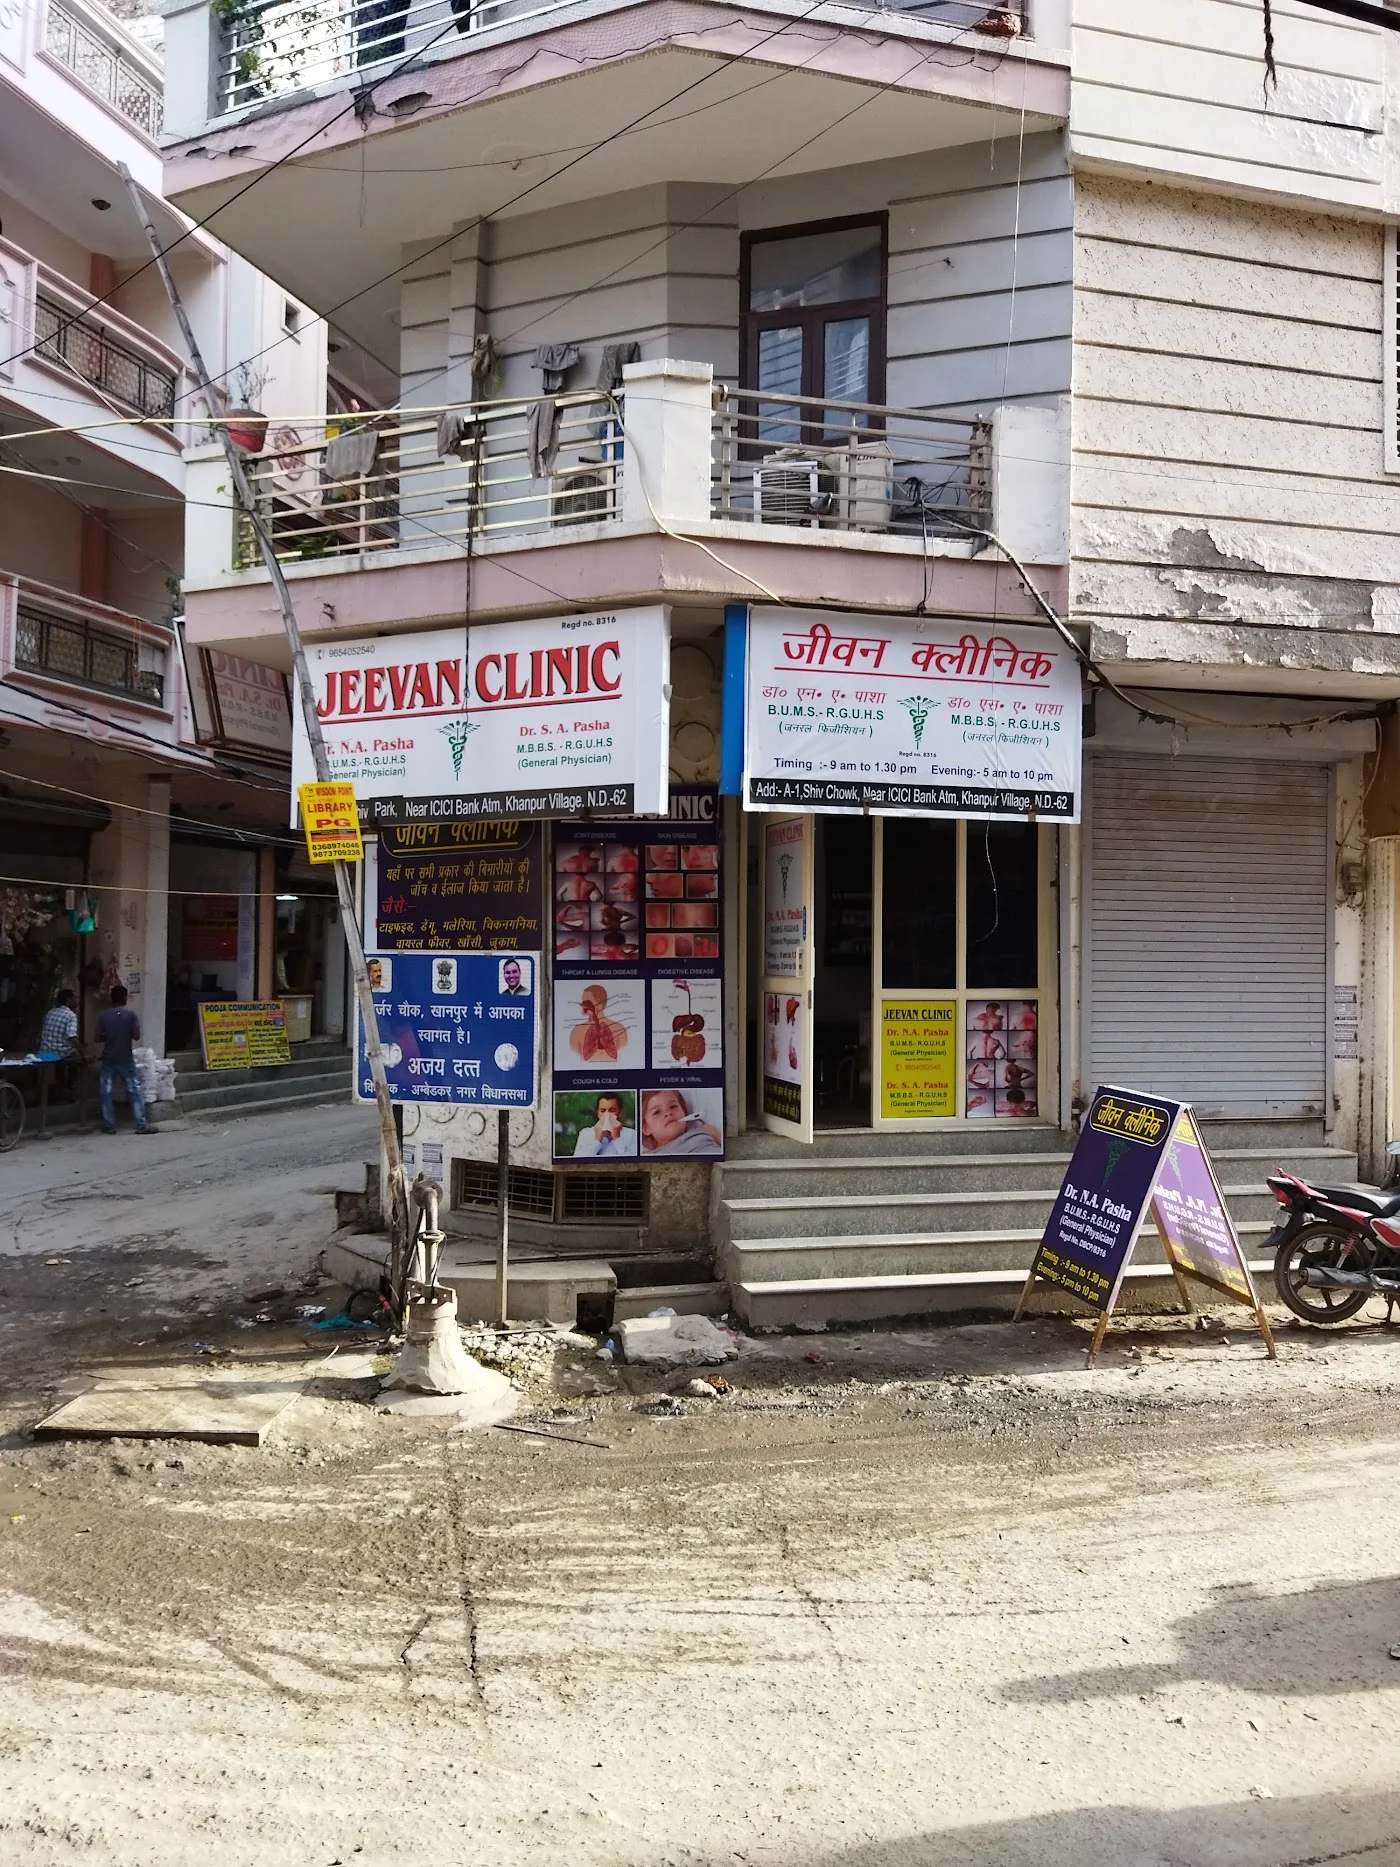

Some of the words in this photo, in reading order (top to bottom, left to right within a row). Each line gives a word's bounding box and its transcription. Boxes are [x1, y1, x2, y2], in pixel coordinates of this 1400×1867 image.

[561, 620, 581, 630] Regd
[596, 616, 617, 625] 8316
[328, 645, 376, 658] 9654052540
[782, 623, 891, 668] जीवन
[911, 634, 1058, 680] क्लीनिक
[317, 658, 462, 718] JEEVAN
[475, 640, 621, 702] CLINIC
[854, 690, 887, 704] पाशा
[826, 707, 884, 721] R.G.U.H.S
[1035, 702, 1064, 716] पाशा
[519, 726, 537, 737] Dr.
[541, 724, 553, 735] S.
[556, 723, 569, 734] A.
[573, 720, 610, 732] Pasha
[1008, 718, 1061, 731] R.G.U.H.S
[341, 741, 368, 754] N.A.
[373, 737, 415, 751] Pasha
[565, 737, 613, 750] R.G.U.H.S
[364, 754, 406, 766] R.G.U.H.S
[518, 757, 558, 770] (General
[561, 753, 612, 767] Physician)
[774, 757, 813, 771] Timing
[830, 760, 837, 770] 9
[840, 763, 857, 771] am
[860, 762, 871, 771] to
[874, 762, 897, 773] 1.30
[900, 765, 917, 775] pm
[361, 767, 406, 779] Physician)
[983, 768, 989, 777] 5
[992, 769, 1007, 779] am
[1010, 770, 1020, 779] to
[1023, 770, 1035, 780] 10
[1038, 772, 1053, 782] pm
[374, 801, 398, 818] Park,
[405, 801, 428, 817] Near
[430, 799, 453, 816] ICICI
[455, 798, 480, 815] Bank
[481, 797, 503, 814] Atm,
[505, 795, 547, 814] Khanpur
[587, 788, 627, 807] N.D.-62
[826, 784, 861, 802] Chowk,
[862, 785, 886, 802] Near
[888, 787, 911, 803] ICICI
[913, 788, 937, 804] Bank
[938, 789, 959, 806] Atm,
[961, 790, 999, 809] Khanpur
[1034, 794, 1068, 810] N.D.-62
[307, 802, 353, 813] LIBRARY
[316, 818, 351, 828] PG
[404, 867, 415, 880] पर
[418, 862, 435, 879] सभी
[438, 865, 460, 879] प्रकार
[463, 860, 474, 876] की
[518, 857, 530, 875] की
[410, 880, 428, 896] जाँच
[431, 883, 438, 894] व
[468, 877, 489, 894] किया
[493, 880, 513, 893] जाता
[396, 937, 424, 949] वायरल
[205, 1004, 227, 1012] POOJA
[229, 1003, 281, 1012] COMMUNICATION
[430, 1004, 468, 1023] खानपुर
[474, 1001, 483, 1018] में
[488, 1006, 525, 1020] आपका
[884, 1009, 918, 1020] JEEVAN
[921, 1009, 953, 1020] CLINIC
[417, 1029, 451, 1043] स्वागत
[887, 1028, 899, 1036] Dr.
[923, 1028, 949, 1036] Pasha
[407, 1057, 445, 1076] अजय
[452, 1058, 481, 1078] दत्त
[411, 1081, 452, 1097] अम्बेडकर
[457, 1086, 476, 1098] नगर
[481, 1083, 527, 1101] विधानसभा
[923, 1081, 949, 1089] Pasha
[1097, 1099, 1126, 1127] जीवन
[1124, 1107, 1165, 1137] क्लीनिक
[1064, 1183, 1078, 1200] Dr.
[1079, 1189, 1099, 1209] N.A.
[1101, 1197, 1132, 1222] Pasha
[1059, 1214, 1084, 1233] (General
[1083, 1225, 1116, 1248] Physician)
[1090, 1213, 1121, 1234] R.G.U.H.S
[1041, 1247, 1059, 1265] Timing
[1064, 1259, 1070, 1269] 9
[1069, 1263, 1079, 1274] am
[1079, 1267, 1086, 1277] to
[1086, 1270, 1100, 1283] 1.30
[1099, 1278, 1110, 1289] pm
[1060, 1274, 1067, 1283] 5
[1065, 1278, 1075, 1288] pm
[1074, 1281, 1081, 1292] to
[1081, 1285, 1090, 1295] 10
[1088, 1290, 1099, 1302] pm
